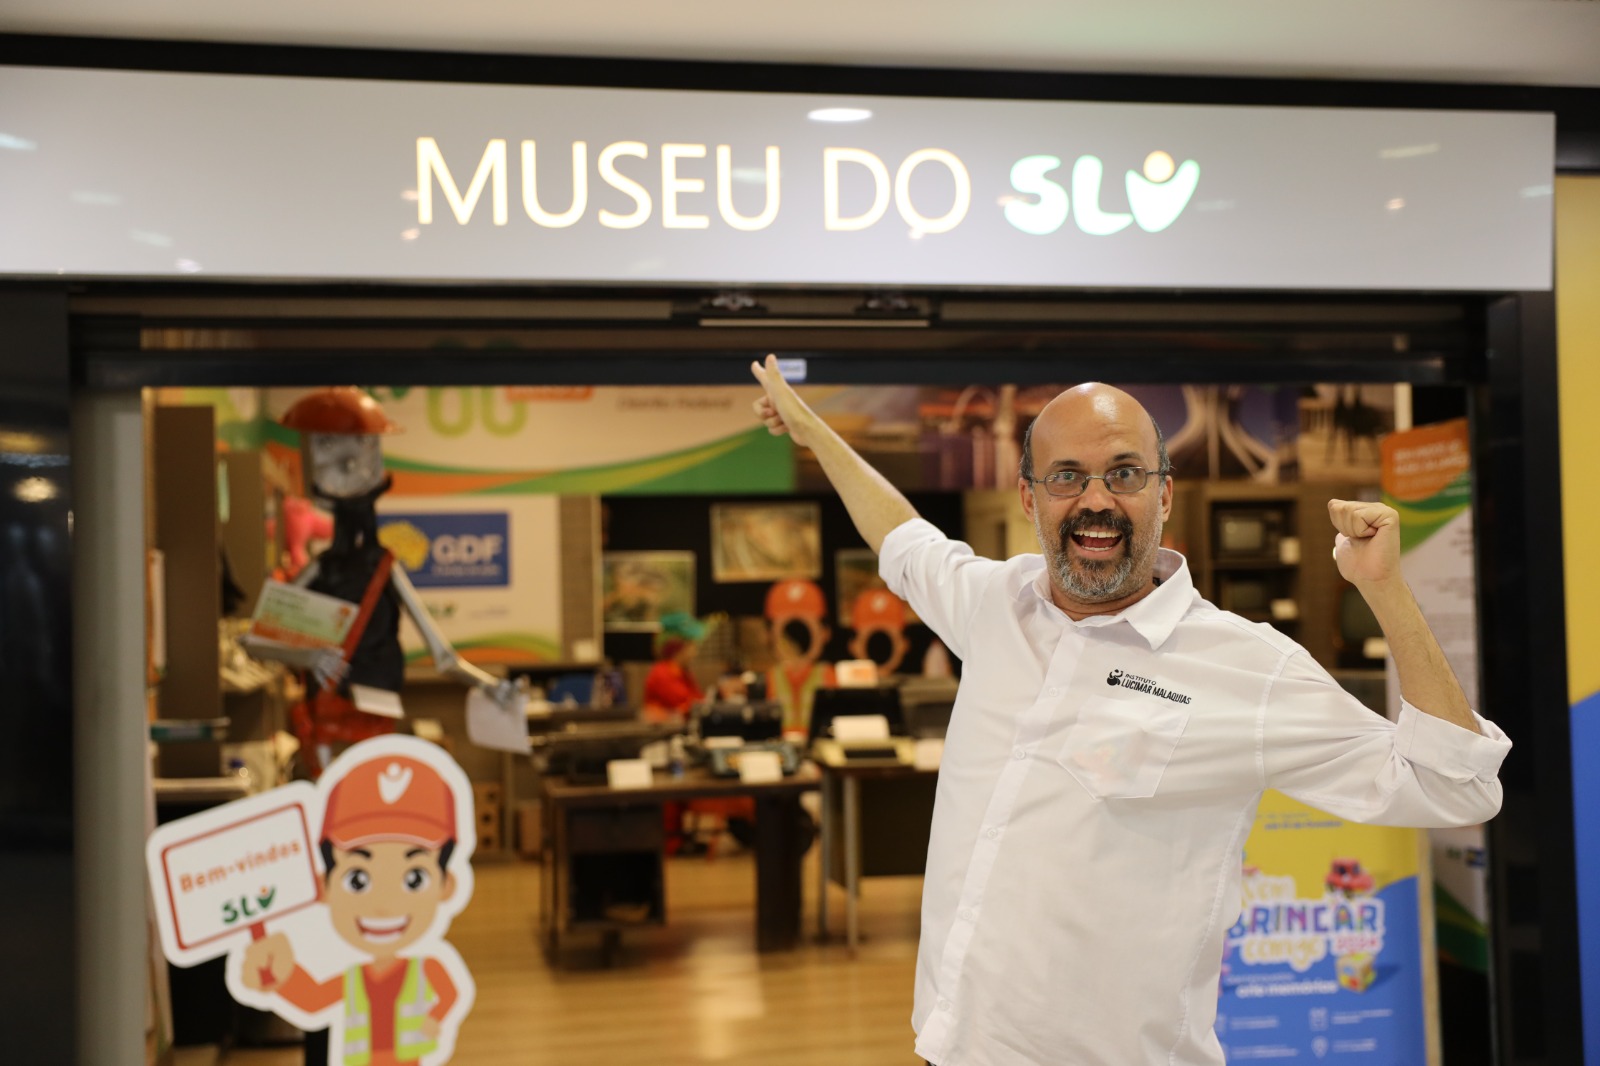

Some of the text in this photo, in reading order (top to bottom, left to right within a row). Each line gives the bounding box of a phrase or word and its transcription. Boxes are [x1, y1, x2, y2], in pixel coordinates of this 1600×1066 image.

[416, 137, 781, 231] MUSEU
[823, 147, 971, 234] DO
[432, 534, 503, 564] GDF
[1121, 679, 1192, 705] LUCIMAR MALAQUIAS
[1125, 673, 1157, 686] INSTITUTO
[179, 839, 300, 893] Bem-vindos
